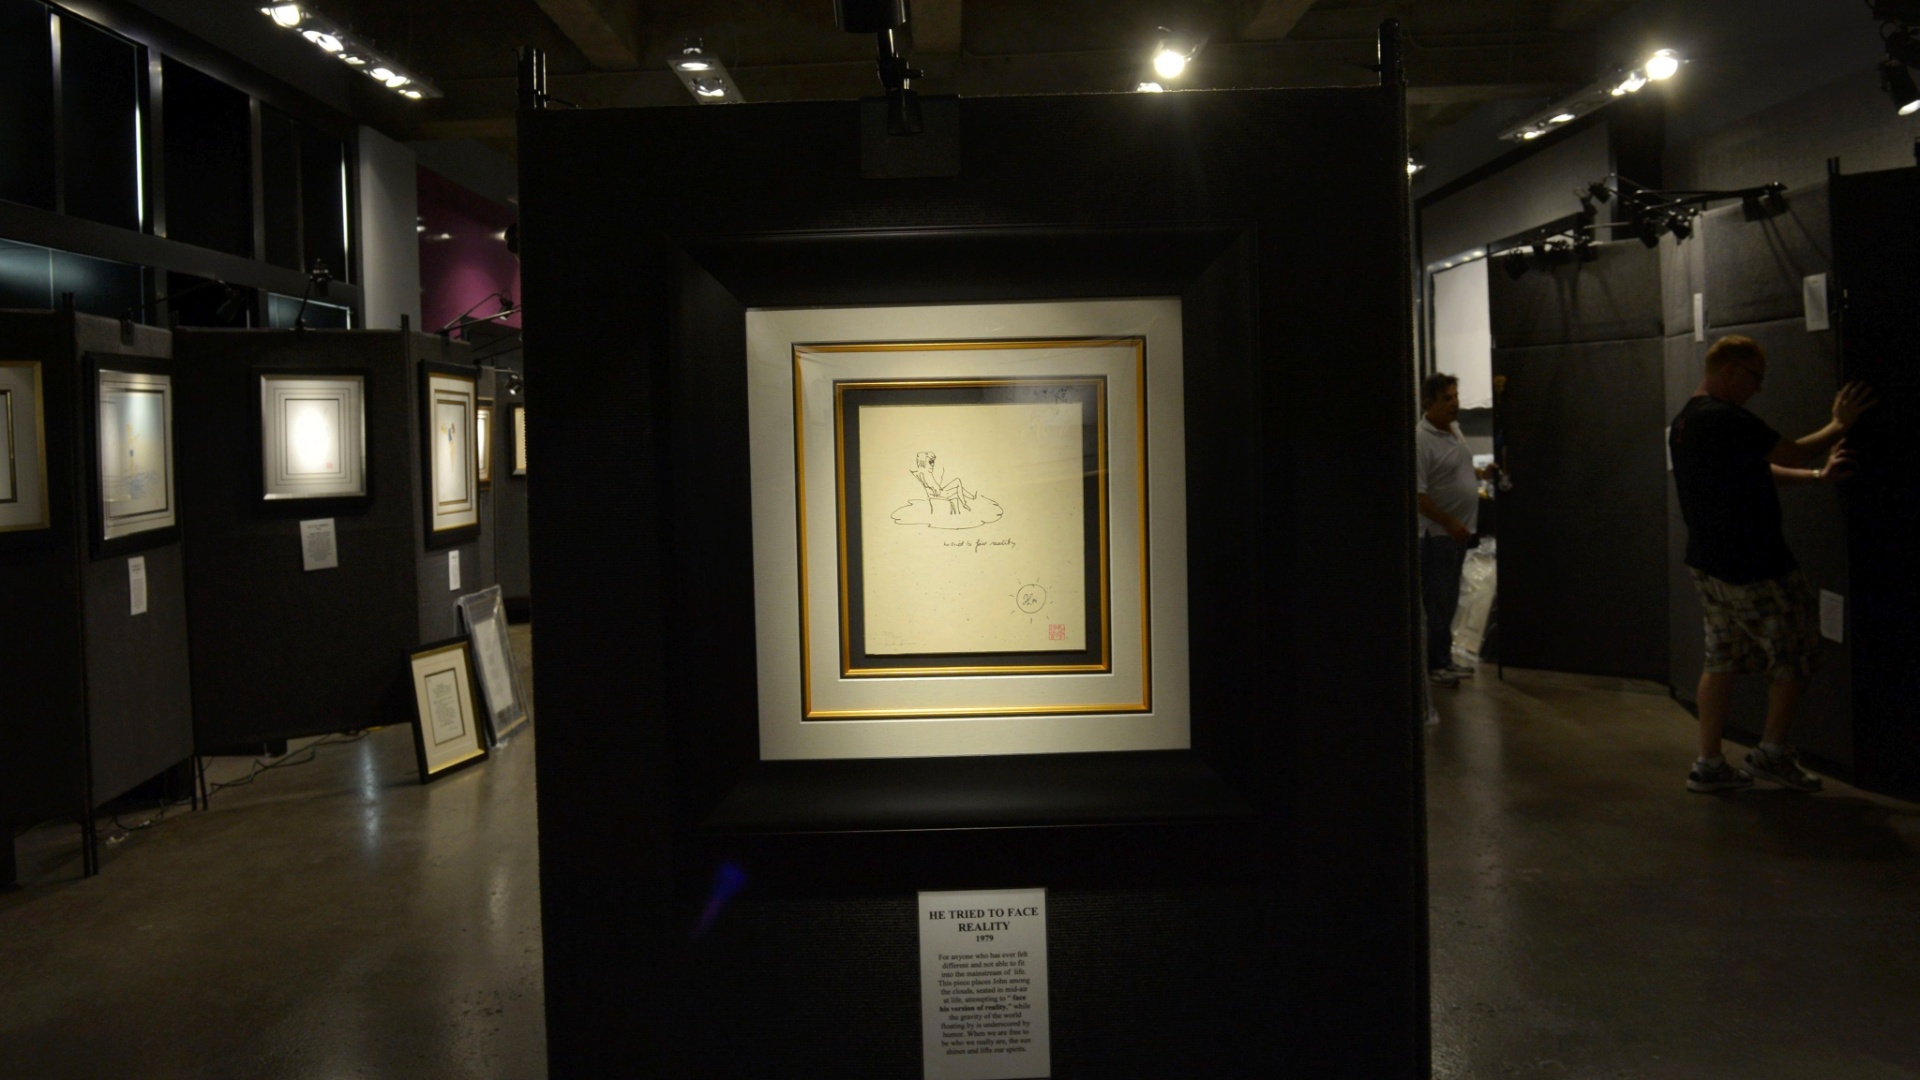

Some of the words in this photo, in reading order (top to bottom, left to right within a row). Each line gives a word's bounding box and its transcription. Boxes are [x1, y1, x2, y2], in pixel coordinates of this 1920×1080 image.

[929, 911, 945, 920] HE
[948, 910, 985, 919] TRIED
[988, 909, 1004, 917] TO
[1008, 907, 1039, 916] FACE
[958, 922, 1010, 931] REALITY
